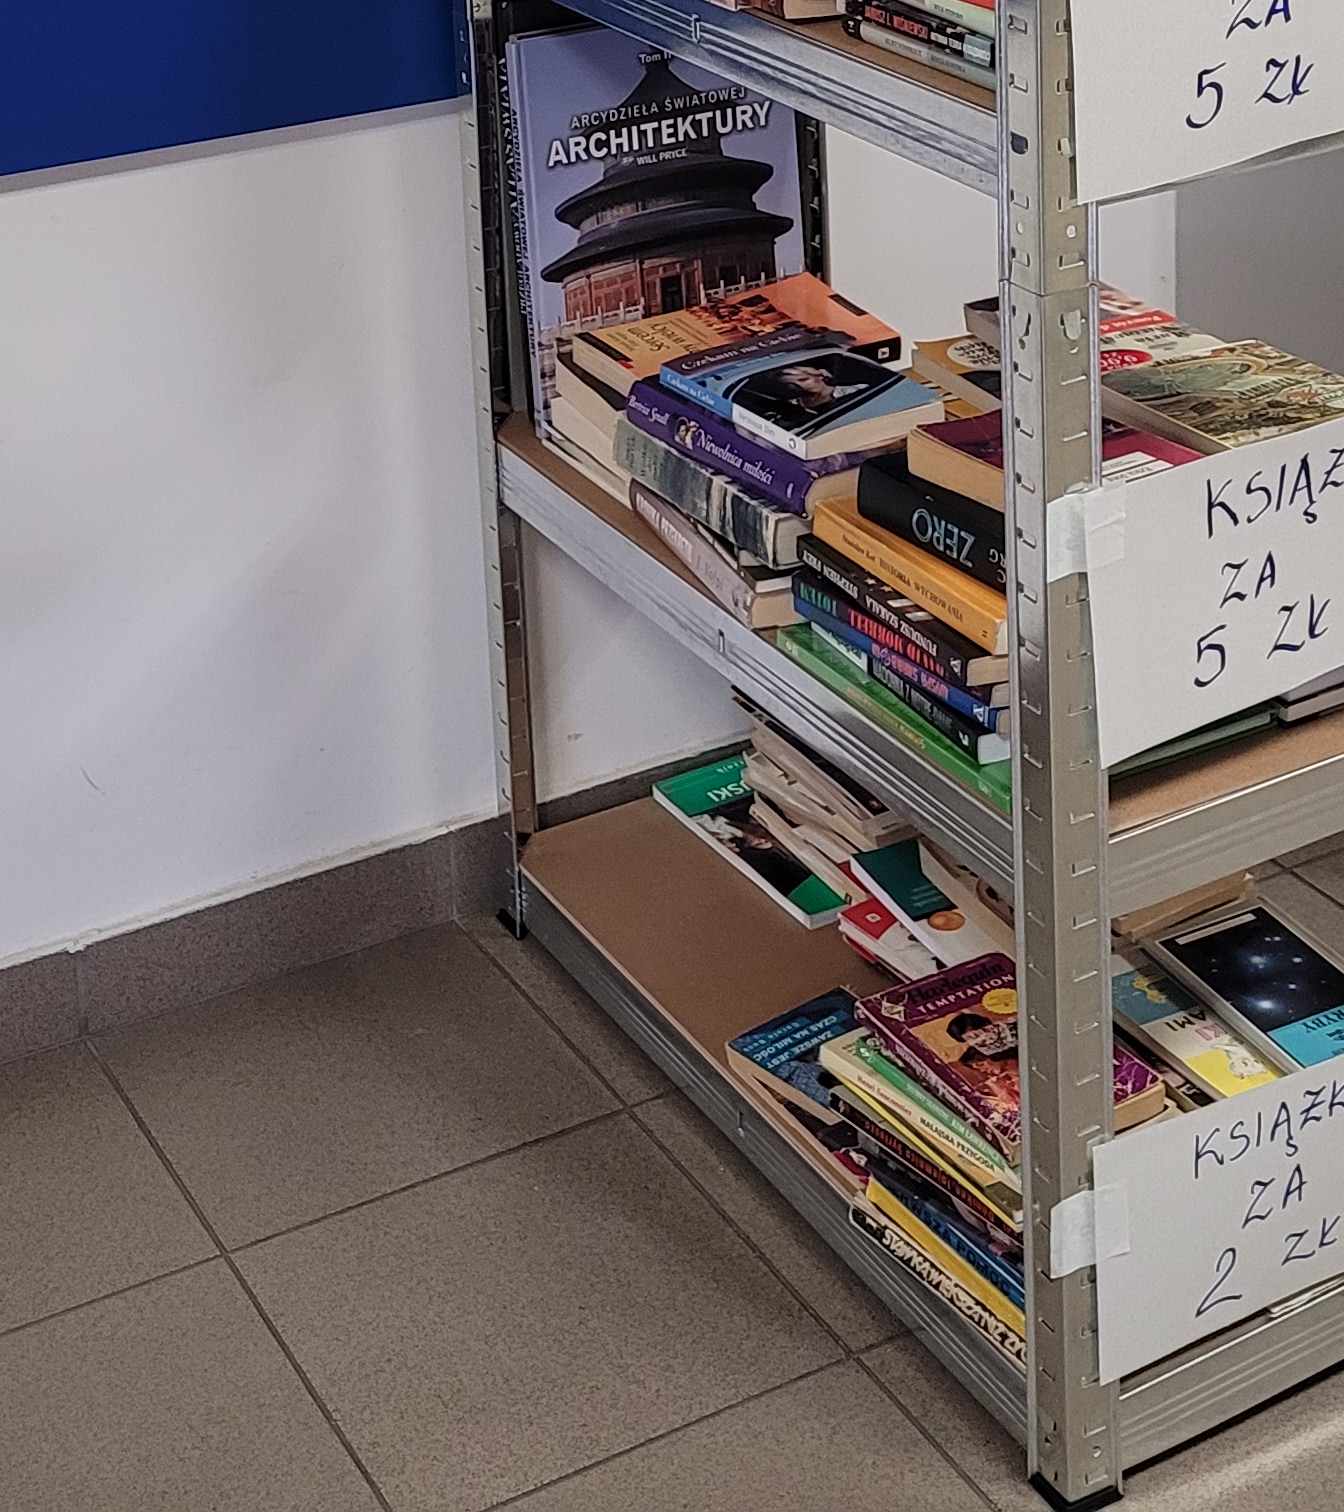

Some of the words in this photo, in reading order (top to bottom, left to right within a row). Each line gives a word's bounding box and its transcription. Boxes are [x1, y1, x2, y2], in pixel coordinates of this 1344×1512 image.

[638, 52, 661, 65] Tom
[570, 100, 660, 130] ARCYDZIEŁA
[664, 86, 746, 113] ŚWIATOWEJ
[1185, 62, 1228, 130] 5
[547, 100, 771, 168] ARCHITEKTURY
[636, 153, 658, 166] WILL
[659, 148, 688, 163] PRYCE
[511, 108, 523, 184] ARCYDZIEŁA
[517, 188, 529, 261] ŚWIATOWEJ
[523, 261, 538, 360] ARCHITEKTURY
[739, 344, 758, 355] na
[649, 406, 671, 426] Small
[694, 428, 743, 469] Niewolnica
[742, 459, 776, 486] miłości
[911, 507, 976, 568] ZERO
[801, 549, 822, 573] FREY
[822, 564, 859, 598] STEPHEN
[1219, 551, 1277, 609] ZA
[799, 583, 839, 617] TOTEM
[878, 557, 912, 587] HISTORIA
[913, 579, 964, 623] WYCHOWANIA
[848, 607, 905, 655] MORRELL
[864, 594, 899, 629] SZAKALA
[899, 619, 937, 657] FUNDUSZ
[1193, 624, 1229, 688] 5
[906, 640, 946, 678] DAVID
[909, 960, 1005, 1003] Harlequin
[917, 972, 1016, 1014] TEMPTATION
[790, 1029, 834, 1056] ZAWSZE
[792, 1026, 811, 1039] NA
[814, 1015, 838, 1033] CZAS
[765, 1051, 790, 1069] JEST
[955, 1137, 995, 1173] PRZYGODA
[1242, 1163, 1308, 1230] ZA
[883, 1228, 930, 1283] STAWKA
[1195, 1246, 1243, 1319] 2
